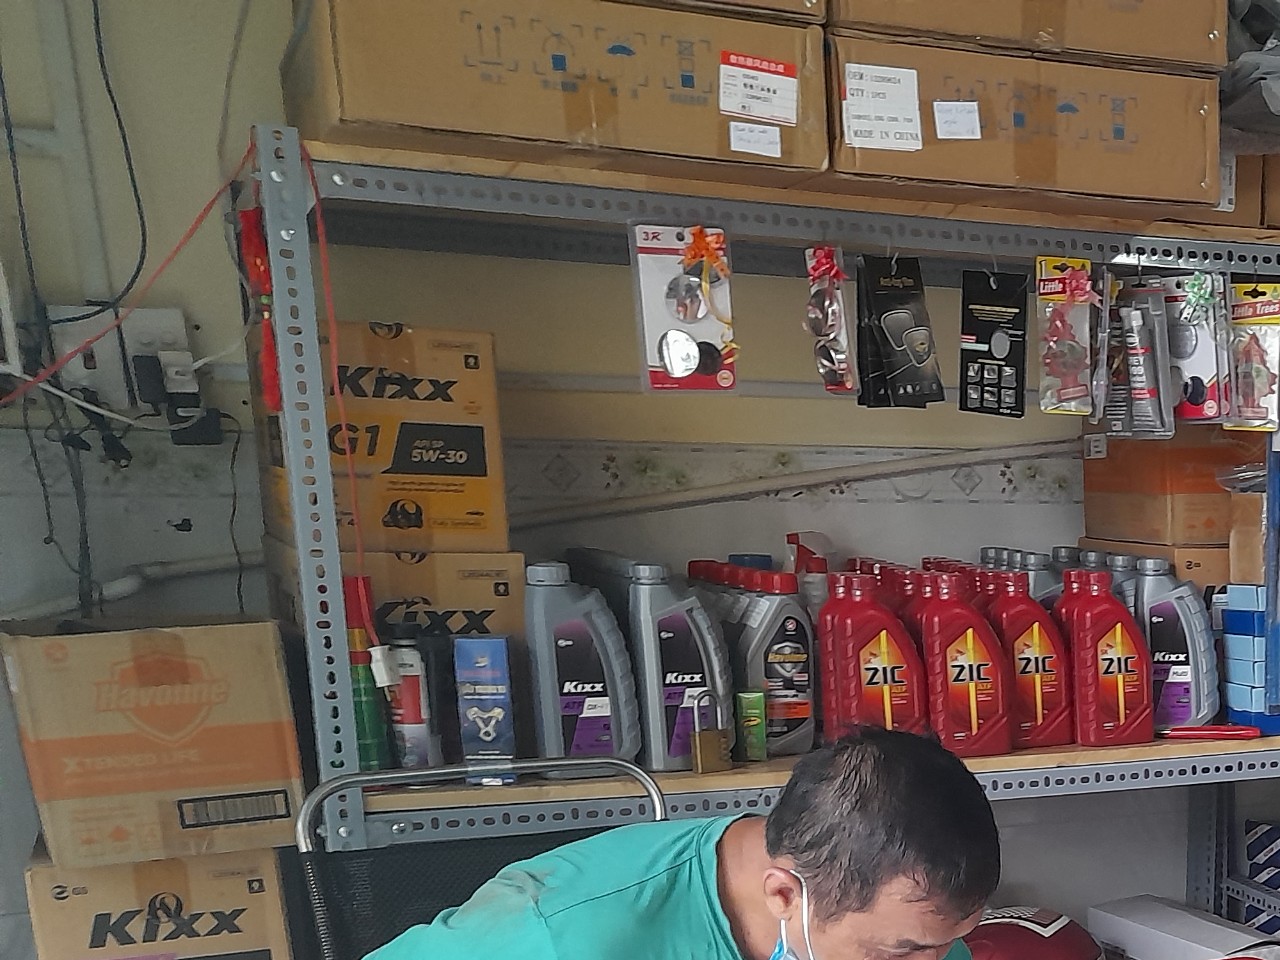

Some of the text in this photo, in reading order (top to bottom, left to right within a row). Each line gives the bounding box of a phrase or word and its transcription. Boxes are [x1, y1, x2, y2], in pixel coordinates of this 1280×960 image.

[852, 129, 921, 142] MADE IN CHINA
[1039, 279, 1064, 293] Little
[1255, 300, 1280, 315] Trees
[330, 365, 458, 402] Kixx
[328, 423, 380, 457] G1
[410, 448, 469, 464] 5W-30
[376, 600, 496, 635] Kixx
[767, 652, 808, 663] Havoline
[1017, 655, 1057, 675] ZIC
[1100, 655, 1139, 676] ZIC
[1153, 651, 1188, 664] Kixx
[665, 672, 703, 685] Kixx
[863, 665, 908, 686] ZIC
[950, 662, 993, 683] ZIC
[562, 681, 605, 694] Kixx
[88, 907, 248, 949] Kixx
